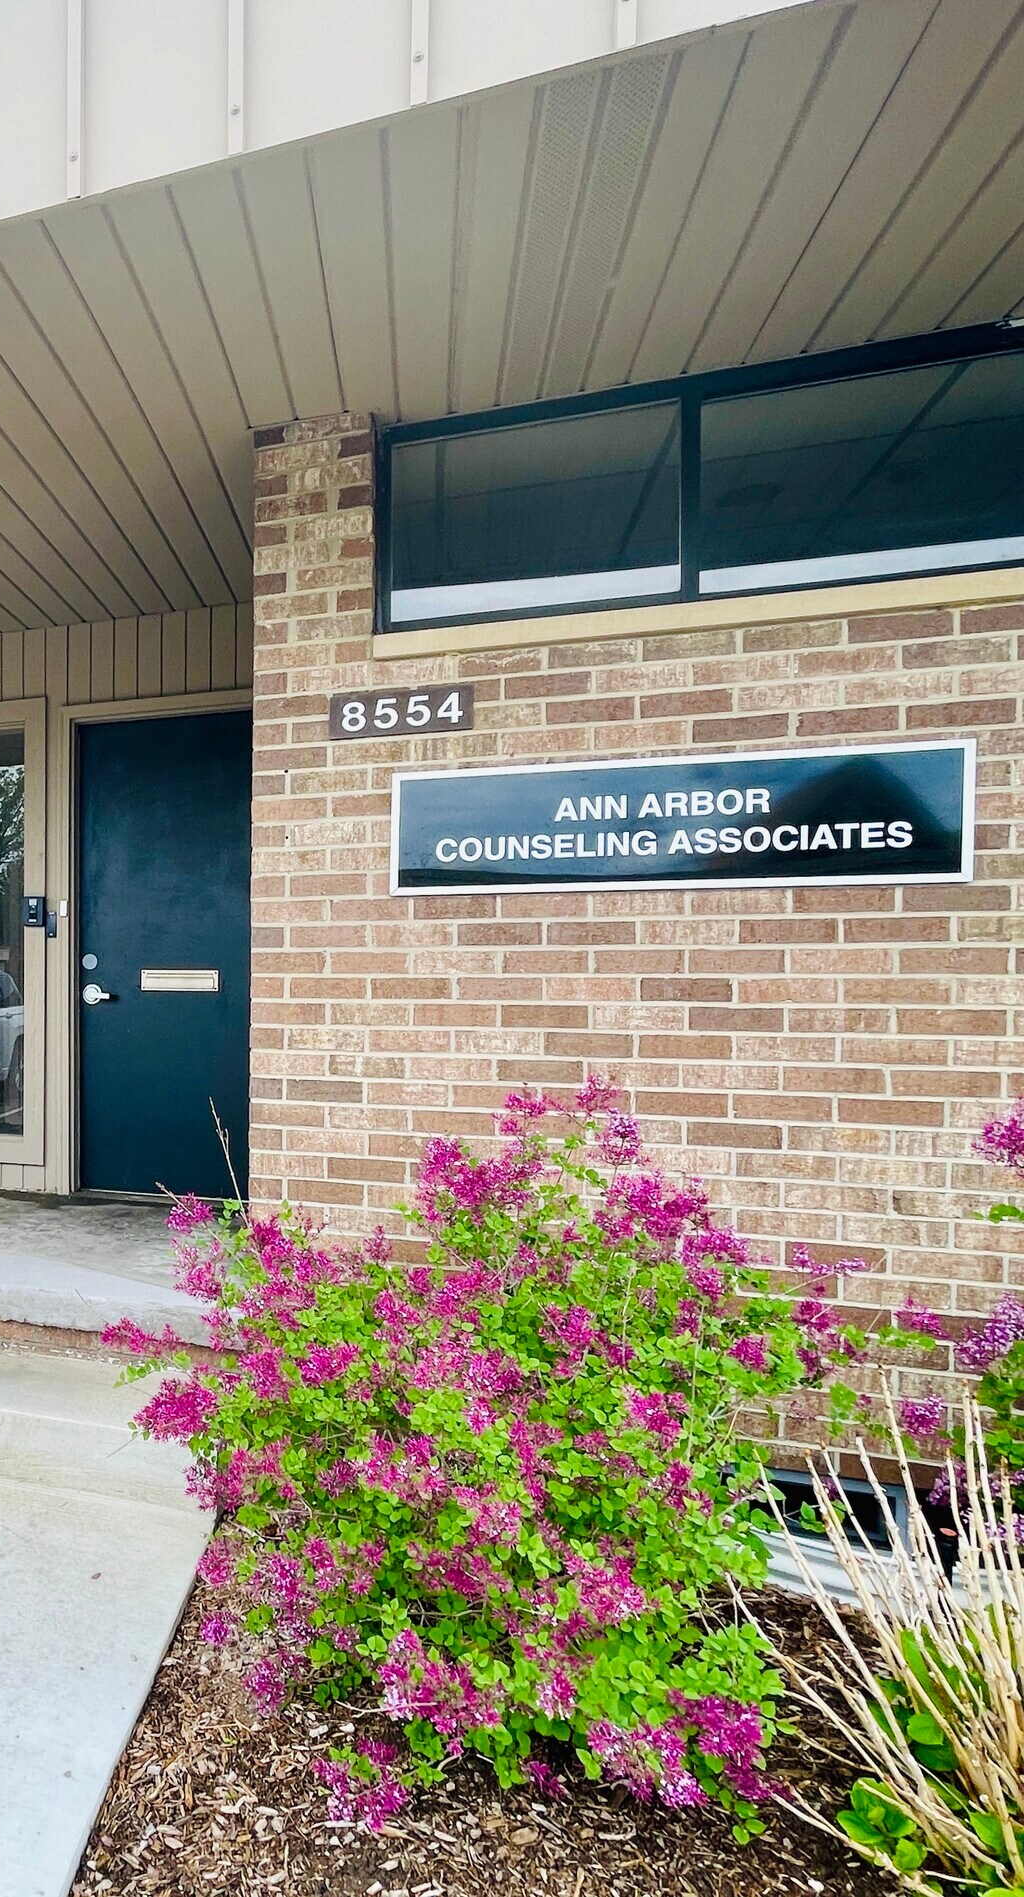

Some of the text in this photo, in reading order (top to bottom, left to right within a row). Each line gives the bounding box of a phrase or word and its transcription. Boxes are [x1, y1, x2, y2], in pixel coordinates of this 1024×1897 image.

[341, 691, 464, 732] 8554
[554, 788, 771, 822] ANN ARBOR
[435, 820, 913, 863] COUNSELING ASSOCIATES
